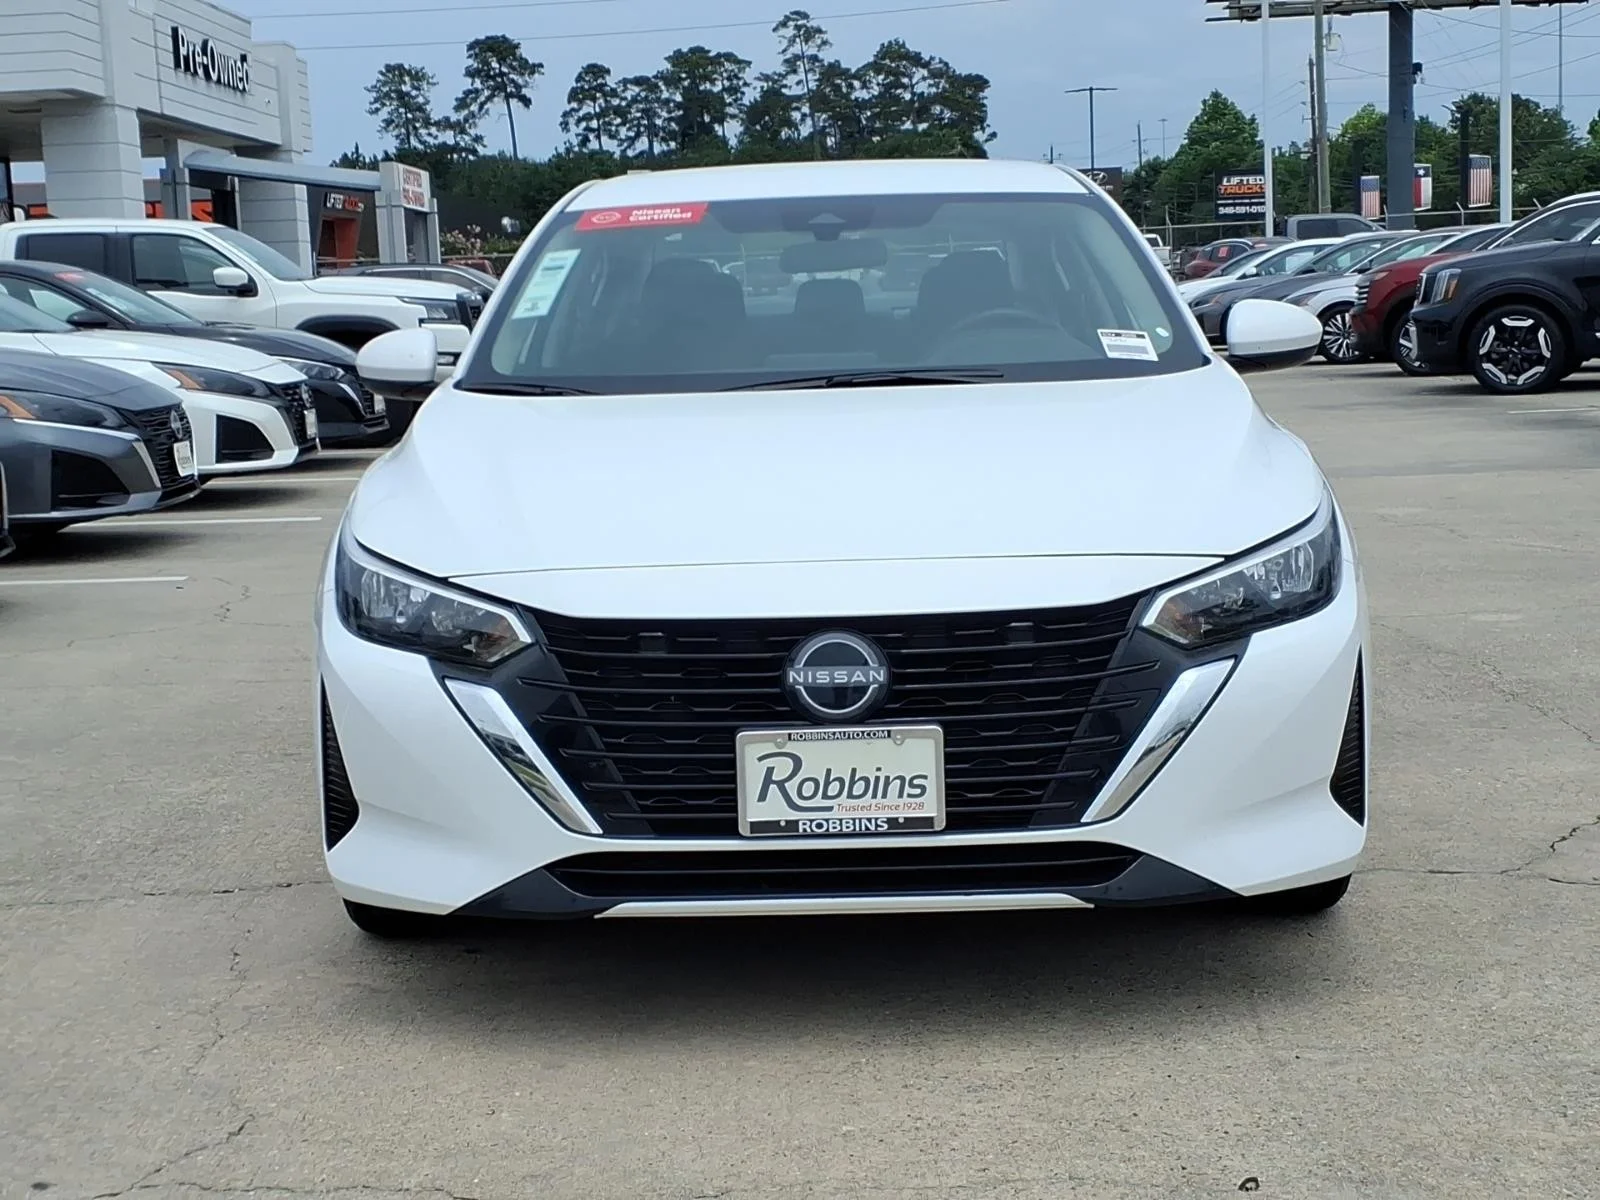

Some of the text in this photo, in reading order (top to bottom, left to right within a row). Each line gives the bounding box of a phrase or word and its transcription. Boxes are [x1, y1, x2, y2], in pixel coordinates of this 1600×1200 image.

[1222, 176, 1265, 185] LIFTED
[629, 212, 692, 222] Certified
[632, 208, 681, 216] Nissan
[789, 669, 885, 684] NISSAN
[791, 730, 888, 741] ROBBINSAUTO.COM
[756, 751, 929, 813] Robbins
[835, 802, 925, 813] Trusted Since 1928
[798, 818, 888, 833] ROBBINS
